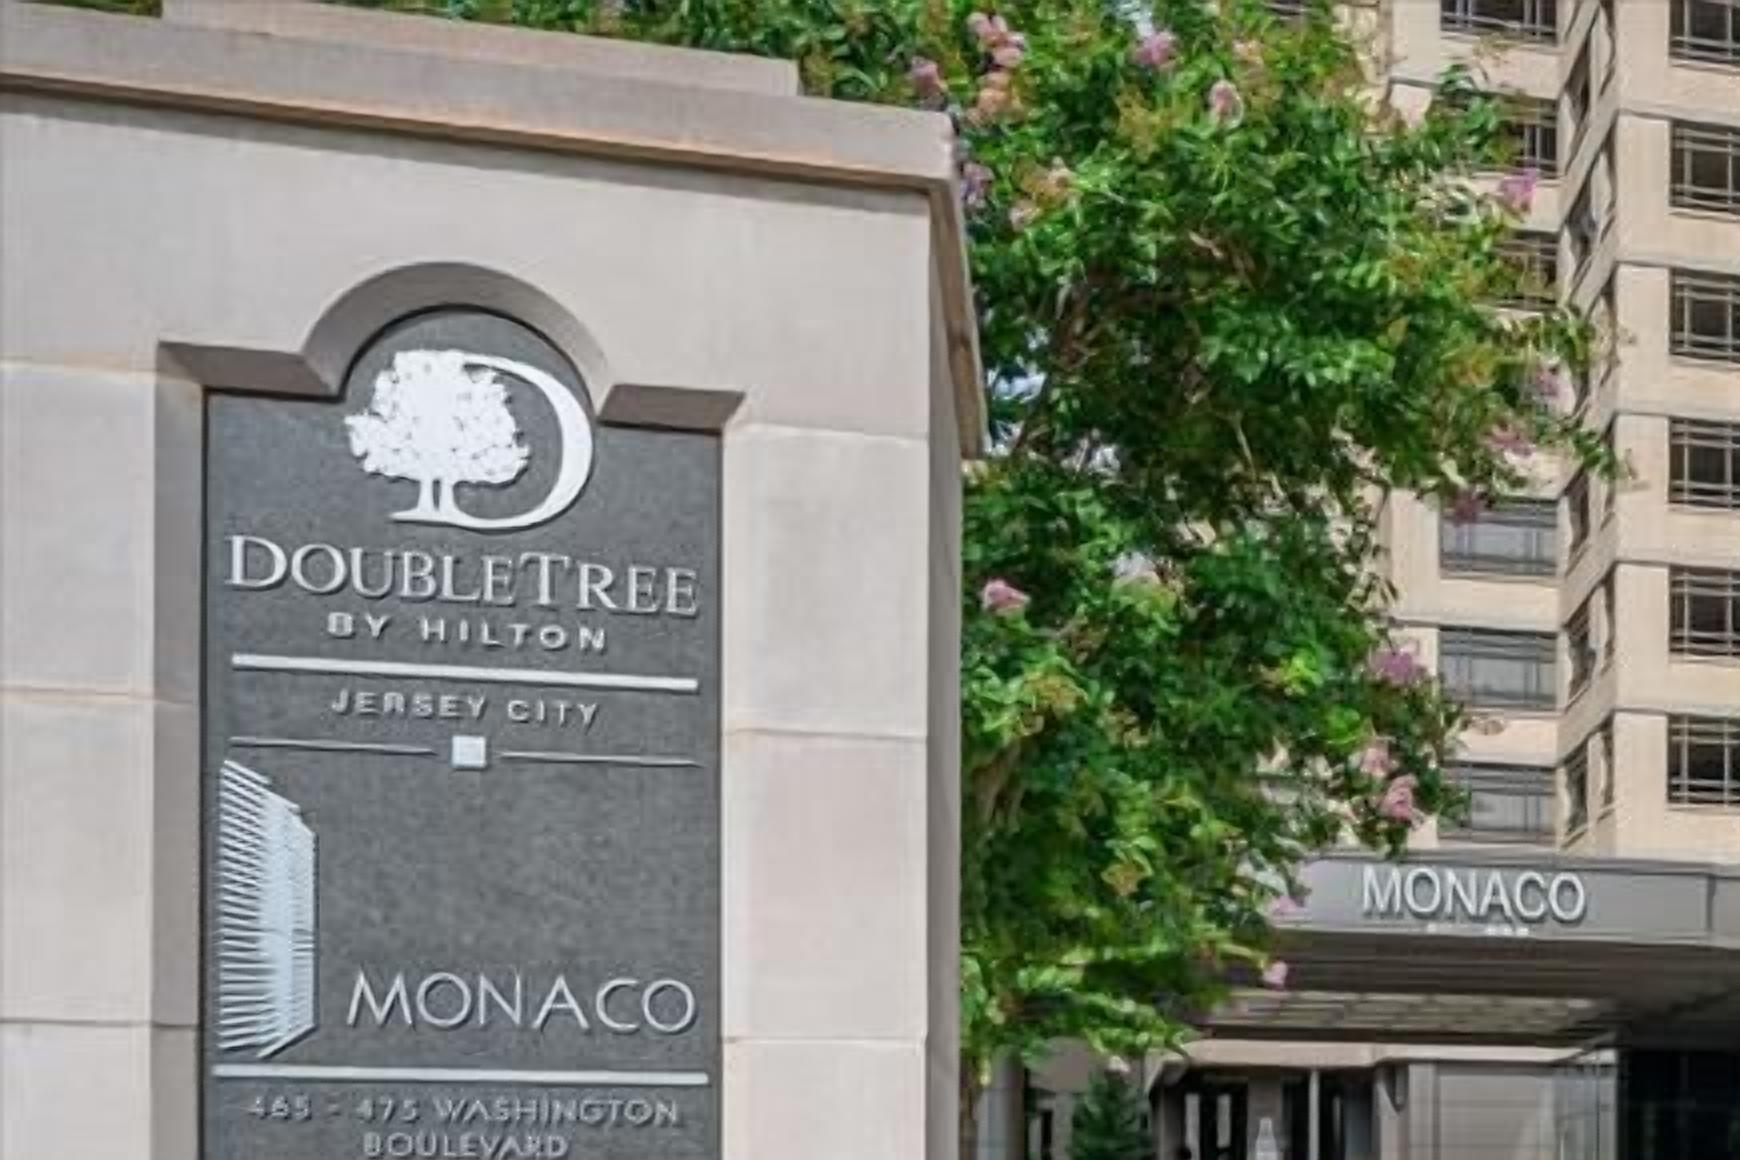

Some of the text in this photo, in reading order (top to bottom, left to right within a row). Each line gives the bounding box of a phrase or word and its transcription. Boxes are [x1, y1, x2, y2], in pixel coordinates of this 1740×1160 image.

[327, 610, 606, 651] BY HILTON
[330, 687, 598, 730] JERSEY CITY
[1363, 862, 1587, 925] MONACO
[346, 970, 696, 1034] MONACO
[355, 1098, 418, 1124] 475
[432, 1096, 678, 1126] WASHINGTON
[362, 1130, 569, 1160] BOULEVARD
